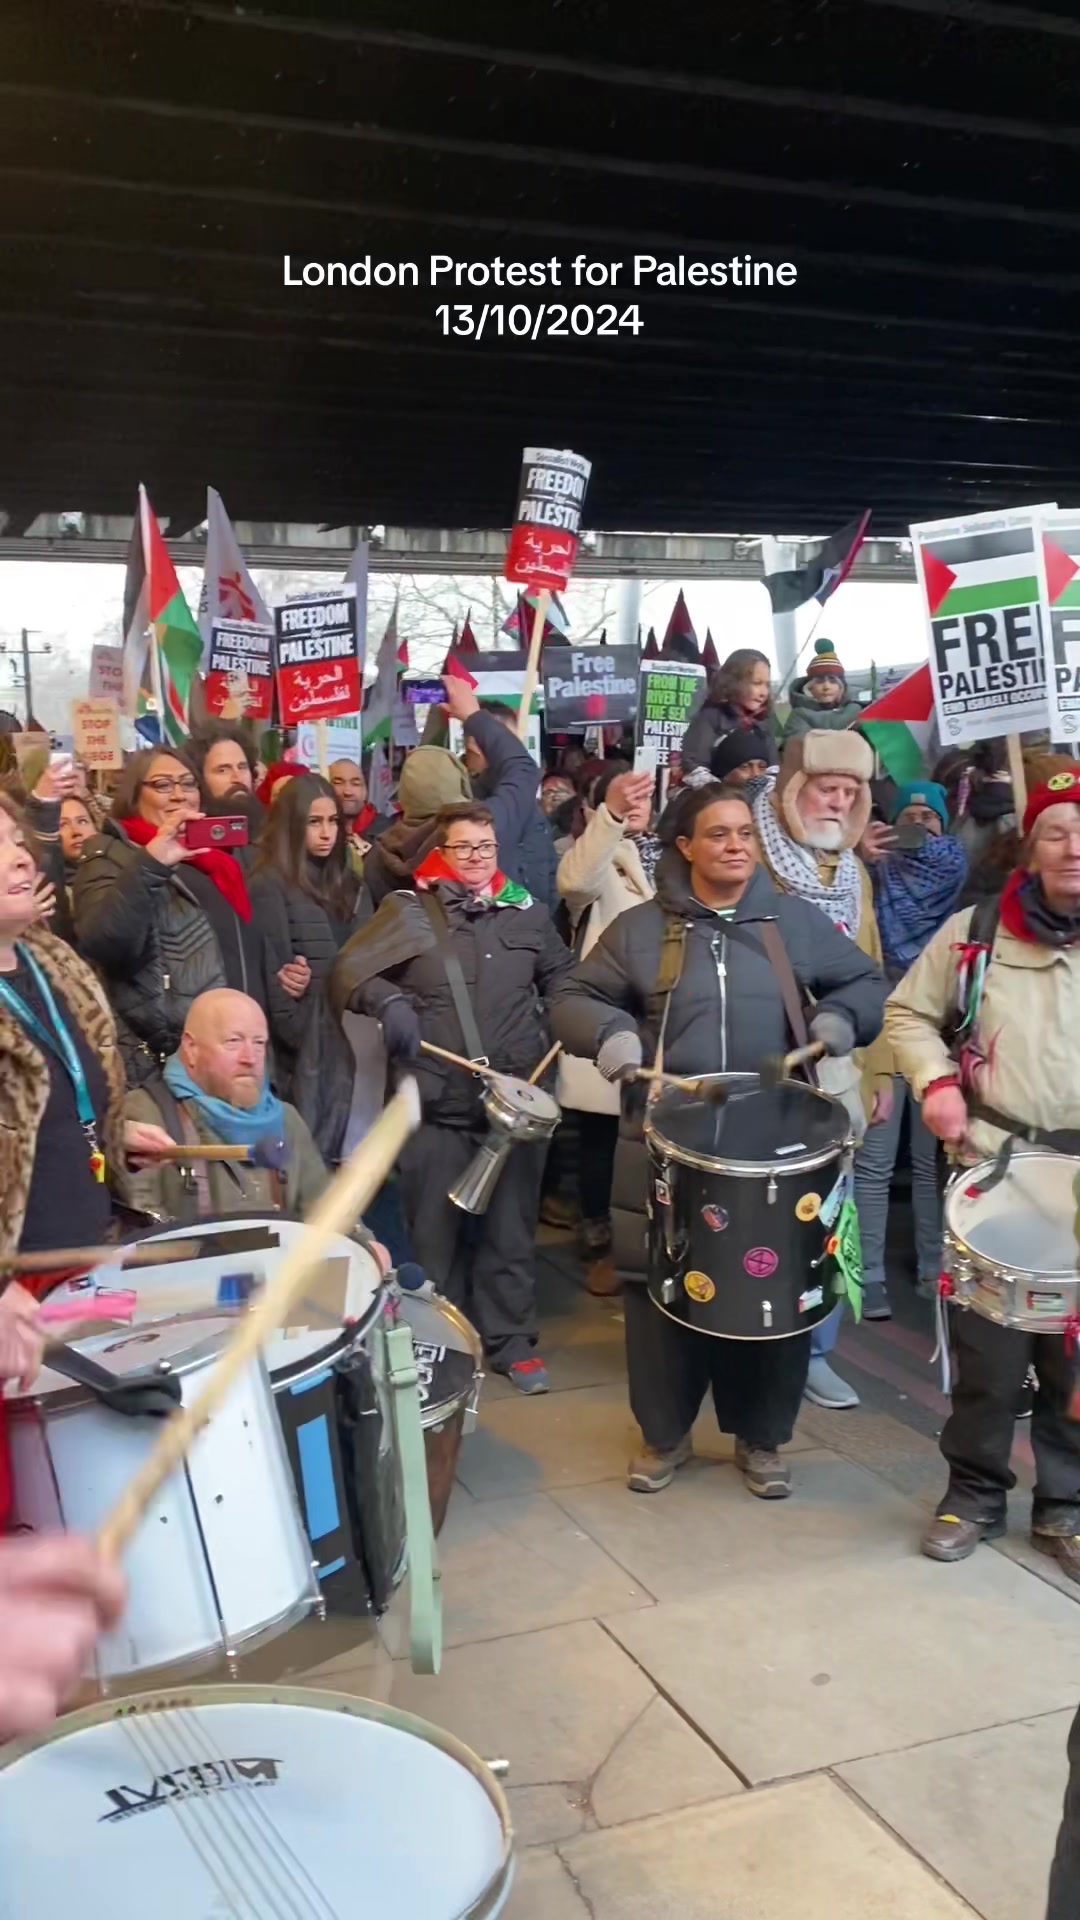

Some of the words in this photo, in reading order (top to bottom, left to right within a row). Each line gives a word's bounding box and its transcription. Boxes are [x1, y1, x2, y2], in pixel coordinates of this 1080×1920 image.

[281, 602, 350, 632] FREEDOM
[215, 631, 270, 653] FREEDOM
[279, 633, 355, 665] PALESTINE
[931, 604, 1045, 674] FRE
[211, 653, 271, 676] PALESTINE
[571, 652, 615, 674] Free
[547, 674, 637, 698] Palestine
[679, 691, 692, 707] TO
[646, 704, 667, 720] THE
[668, 706, 686, 722] SEA
[82, 719, 111, 730] STOP
[86, 735, 107, 746] THE
